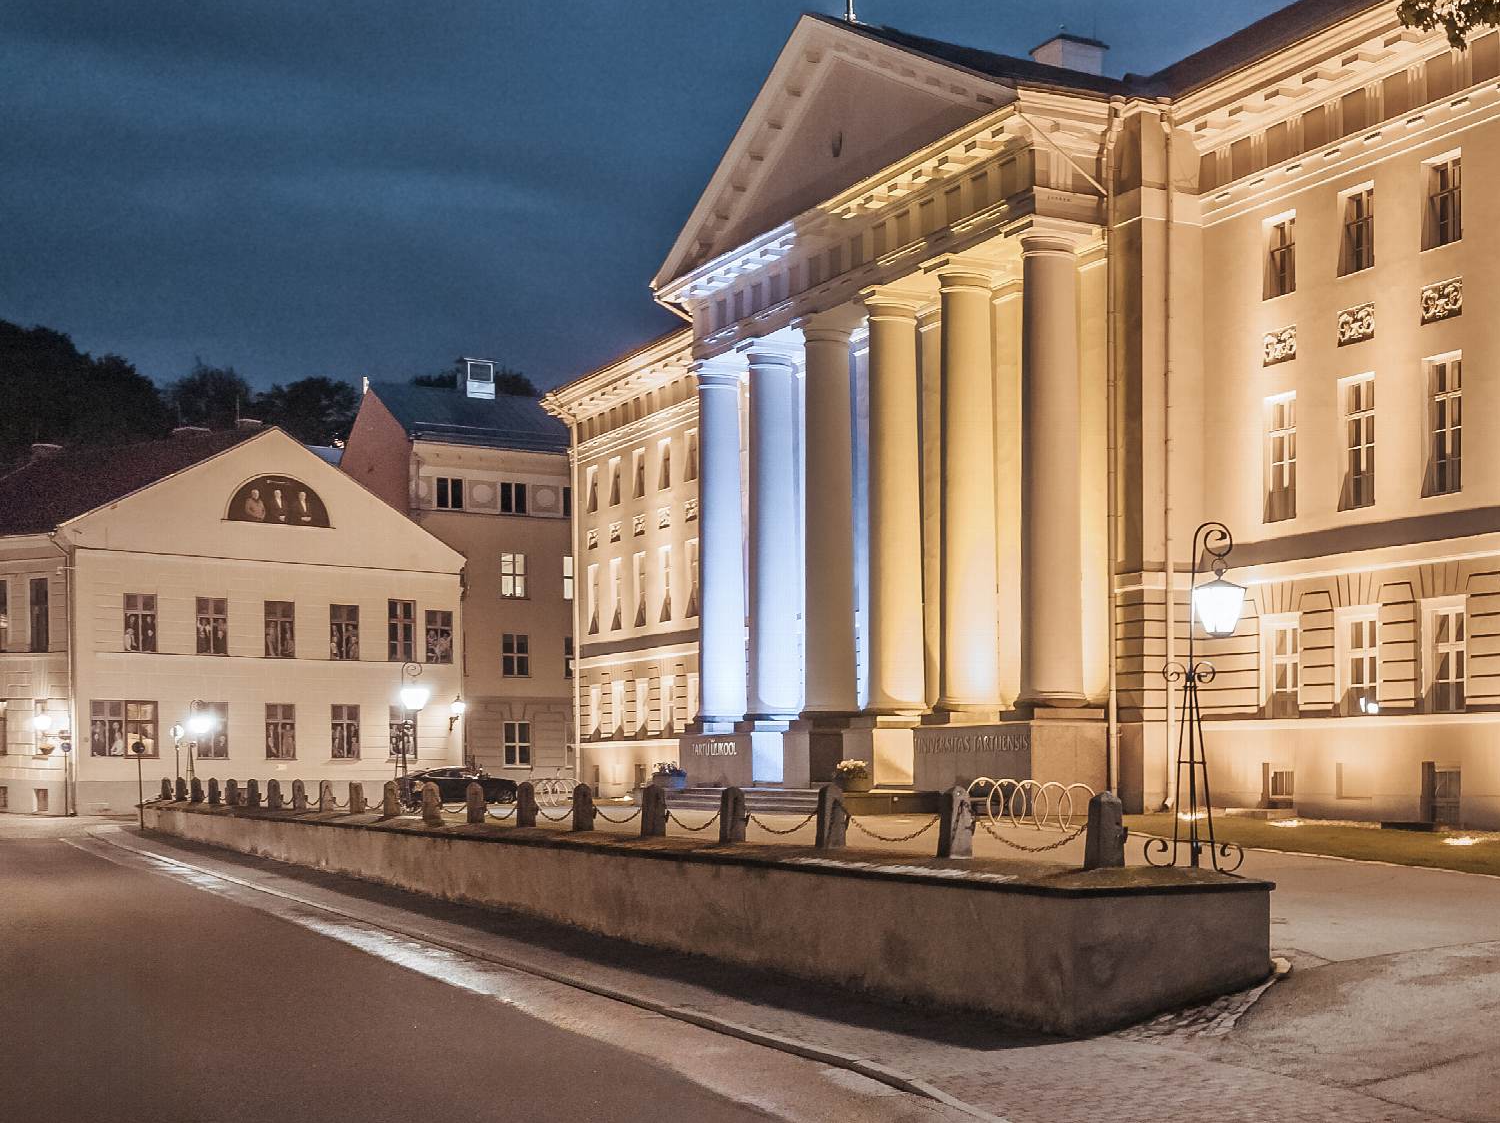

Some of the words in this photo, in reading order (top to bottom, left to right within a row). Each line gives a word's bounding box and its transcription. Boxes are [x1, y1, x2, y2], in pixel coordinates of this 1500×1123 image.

[692, 743, 710, 756] TARTU
[710, 739, 737, 756] ÜLIKOOL
[915, 736, 970, 753] UNIVERSITAS
[973, 734, 1029, 751] TARTUENSIS
